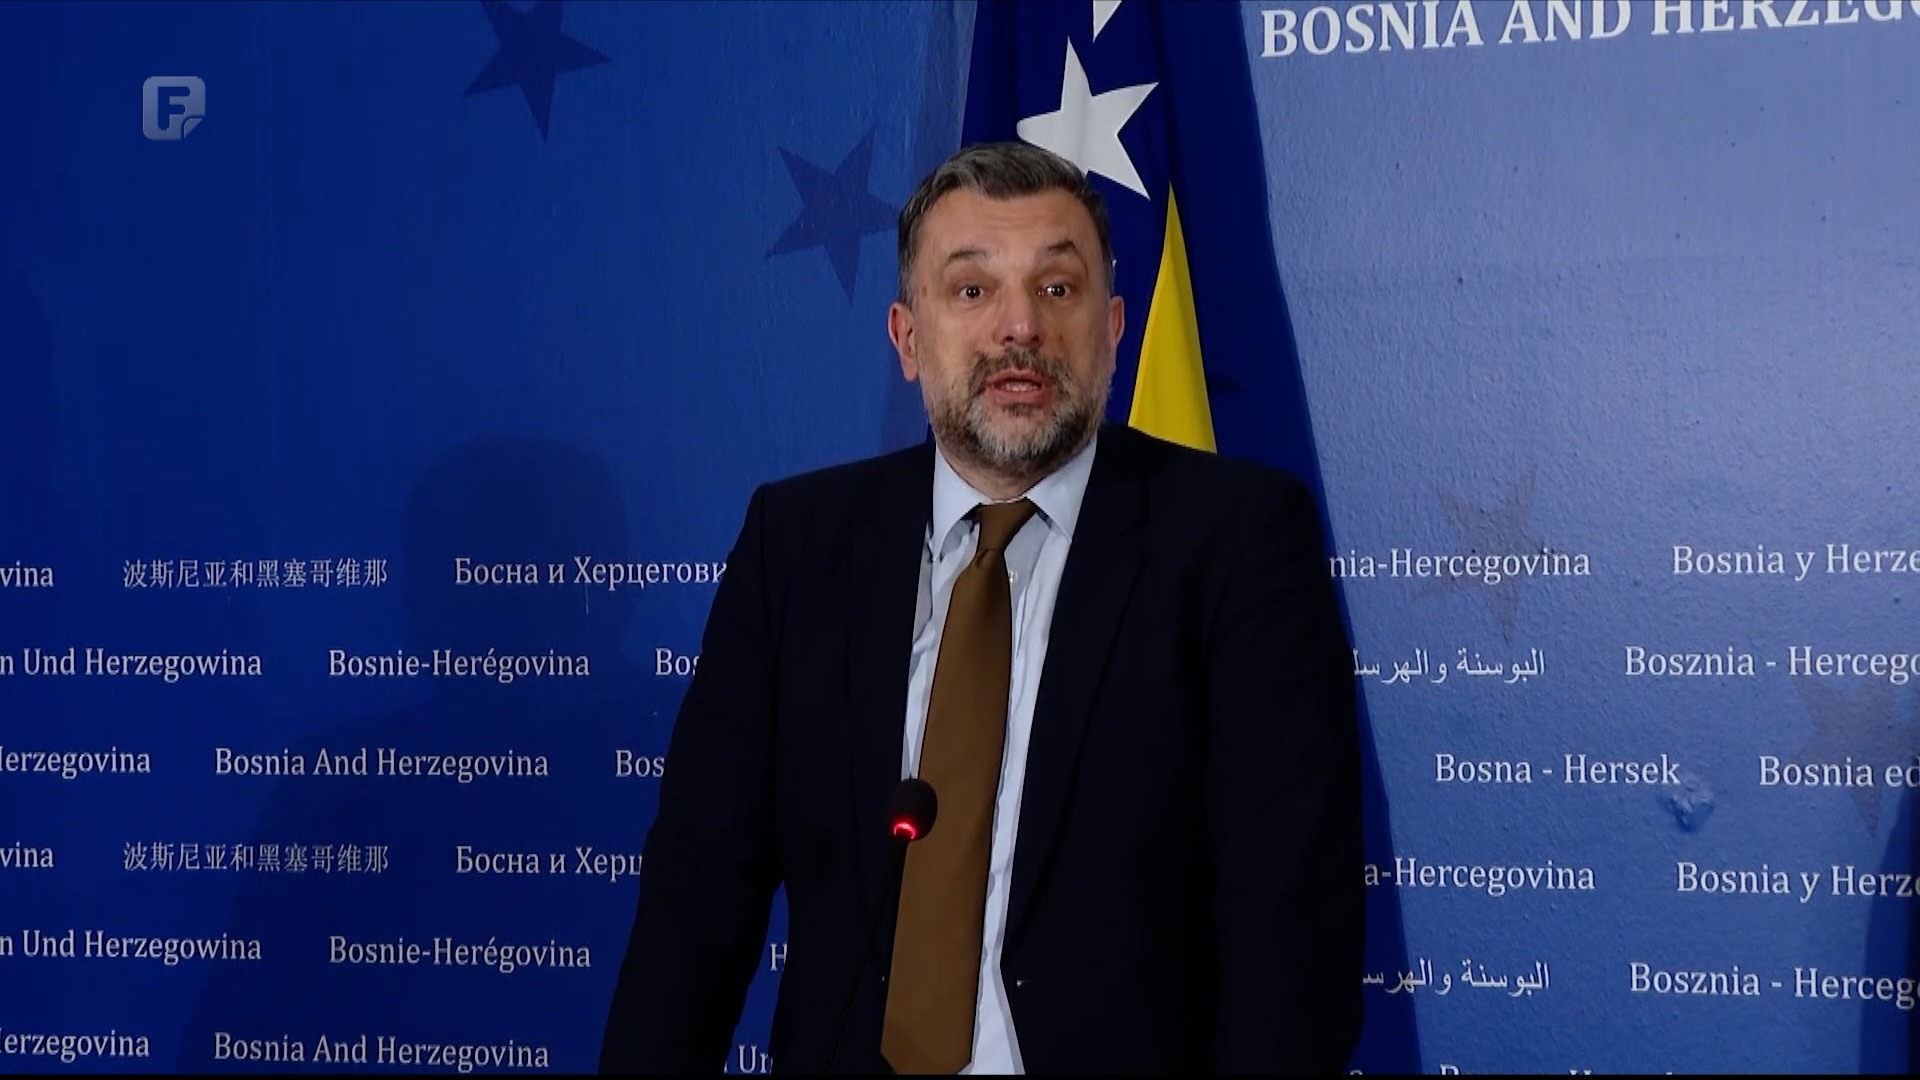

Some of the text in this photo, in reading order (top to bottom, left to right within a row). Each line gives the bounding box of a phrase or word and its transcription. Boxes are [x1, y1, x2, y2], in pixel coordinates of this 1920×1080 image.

[1261, 0, 1484, 57] BOSNIA
[1499, 0, 1631, 45] AND
[0, 560, 54, 587] vina
[123, 558, 387, 589] 波斯尼亚和黑塞哥维那
[455, 558, 539, 585] Босна
[548, 564, 564, 584] и
[1329, 547, 1590, 585] nia-Hercegovina
[1673, 544, 1785, 575] Bosnia
[1795, 552, 1815, 581] y
[24, 647, 76, 675] Und
[85, 648, 262, 683] Herzegowina
[329, 648, 590, 683] Bosnie-Herégovina
[1457, 648, 1544, 684] البوسنة
[1625, 646, 1755, 675] Bosznia
[0, 746, 151, 779] erzegovina
[215, 748, 548, 783] Bosnia And Herzegovina
[616, 749, 664, 777] Bos
[1436, 753, 1532, 783] Bosna
[1564, 754, 1681, 785] Hersek
[1759, 756, 1874, 787] Bosnia
[0, 841, 54, 867] vina
[123, 841, 388, 873] 波斯尼亚和黑塞哥维那
[456, 846, 540, 873] Босна
[550, 854, 566, 874] и
[1365, 856, 1595, 897] a-Hercegovina
[1677, 862, 1920, 903] Bosnia y Herz
[23, 929, 75, 957] Und
[84, 930, 261, 967] Herzegowina
[330, 936, 591, 973] Bosnie-Herégovina
[1461, 958, 1549, 997] البوسنة
[1630, 962, 1760, 995] Bosznia
[1795, 967, 1920, 1010] Herceg
[0, 1027, 149, 1063] erzegovina
[214, 1032, 549, 1073] Bosnia And Herzegovina
